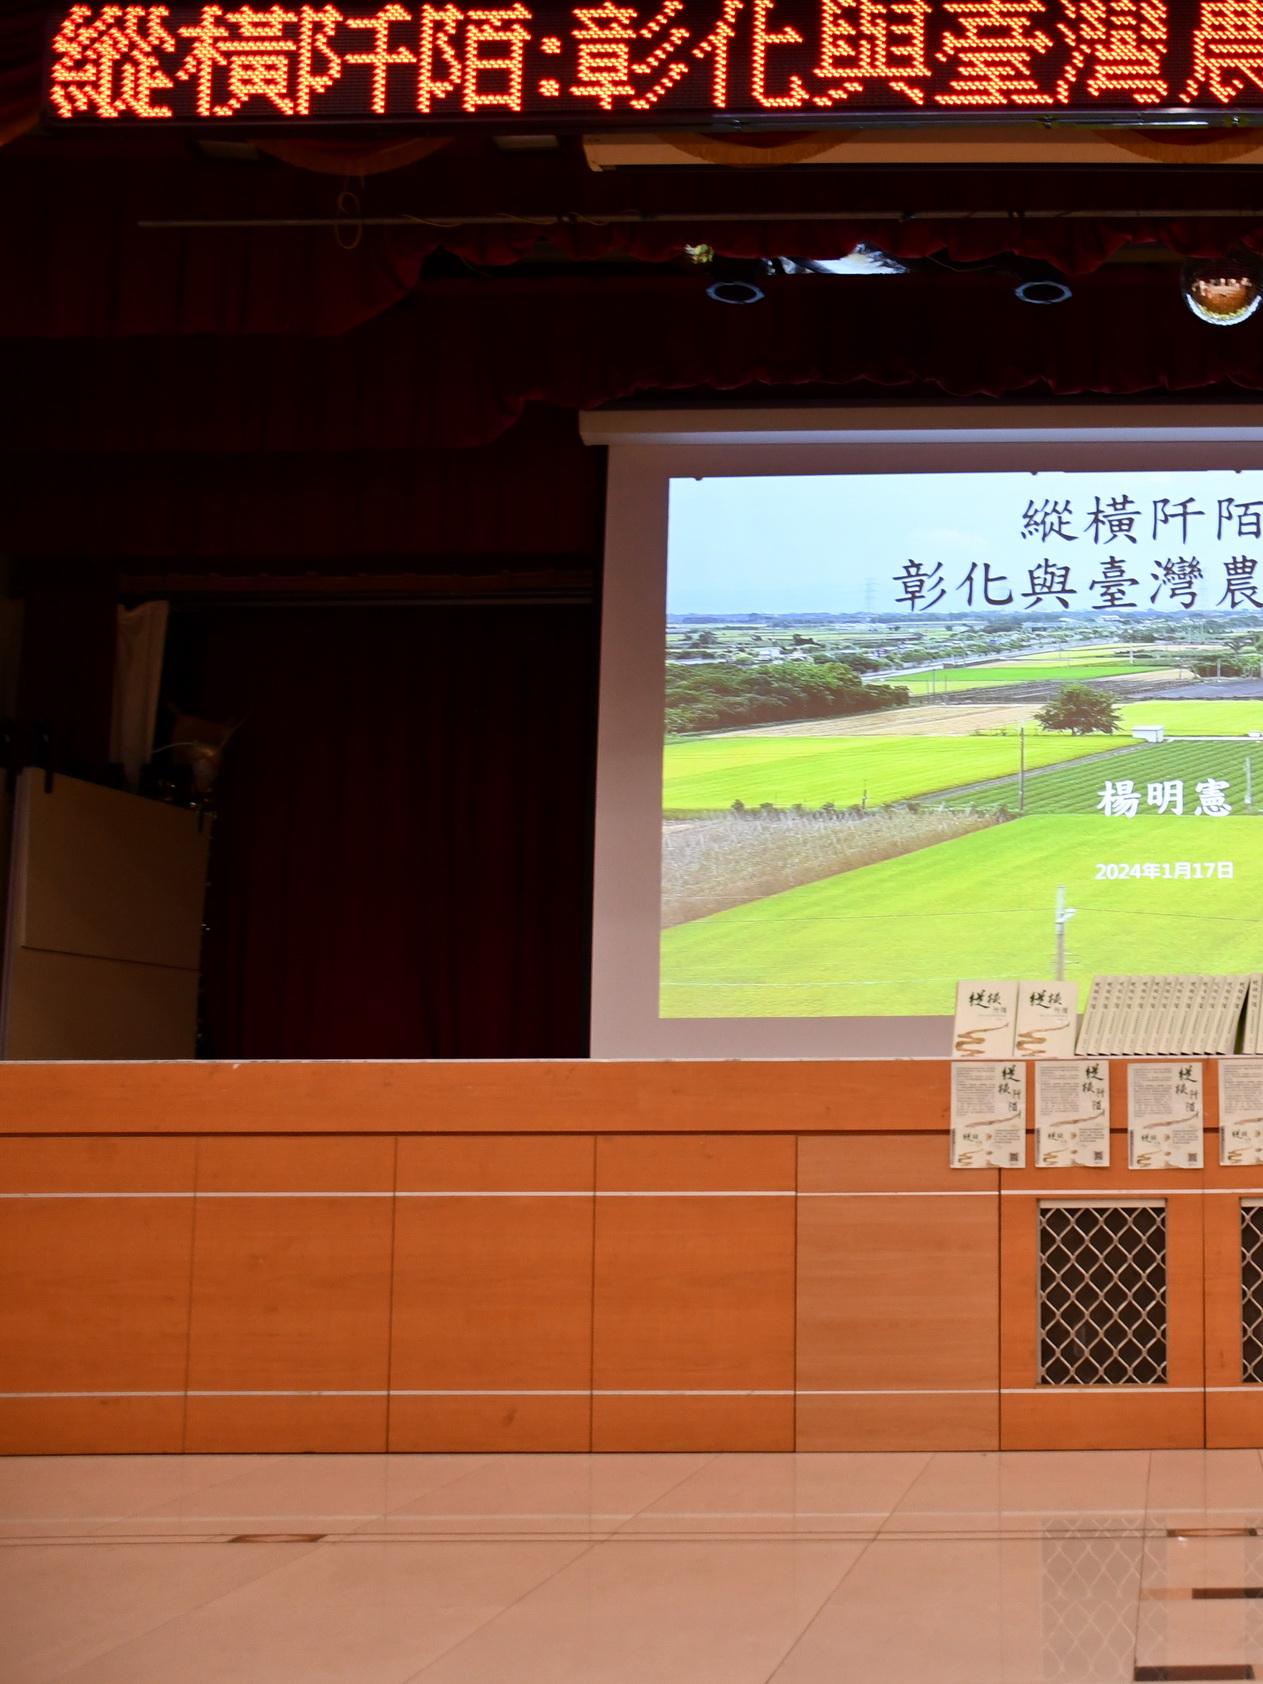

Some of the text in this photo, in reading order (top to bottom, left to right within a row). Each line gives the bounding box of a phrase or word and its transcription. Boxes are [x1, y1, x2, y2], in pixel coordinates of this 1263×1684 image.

[1097, 777, 1232, 818] 楊明憲
[1094, 861, 1234, 880] 2024年1月17日
